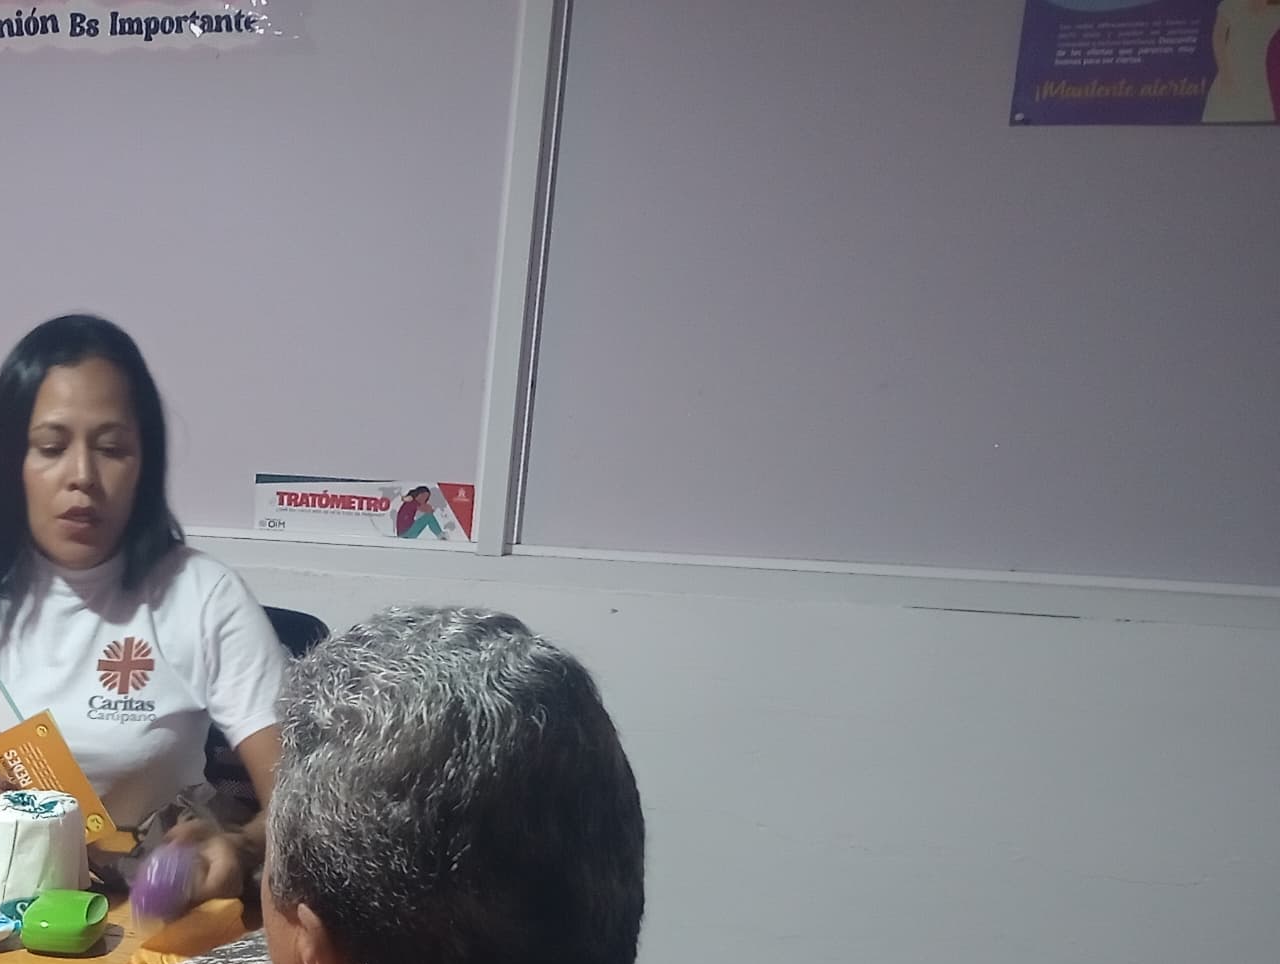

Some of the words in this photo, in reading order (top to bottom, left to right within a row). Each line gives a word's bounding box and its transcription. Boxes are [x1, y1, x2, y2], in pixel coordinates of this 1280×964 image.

[109, 9, 258, 44] Importante
[276, 490, 391, 512] TRATÓMETRO
[88, 695, 156, 712] Caritas
[4, 749, 33, 788] REDES
